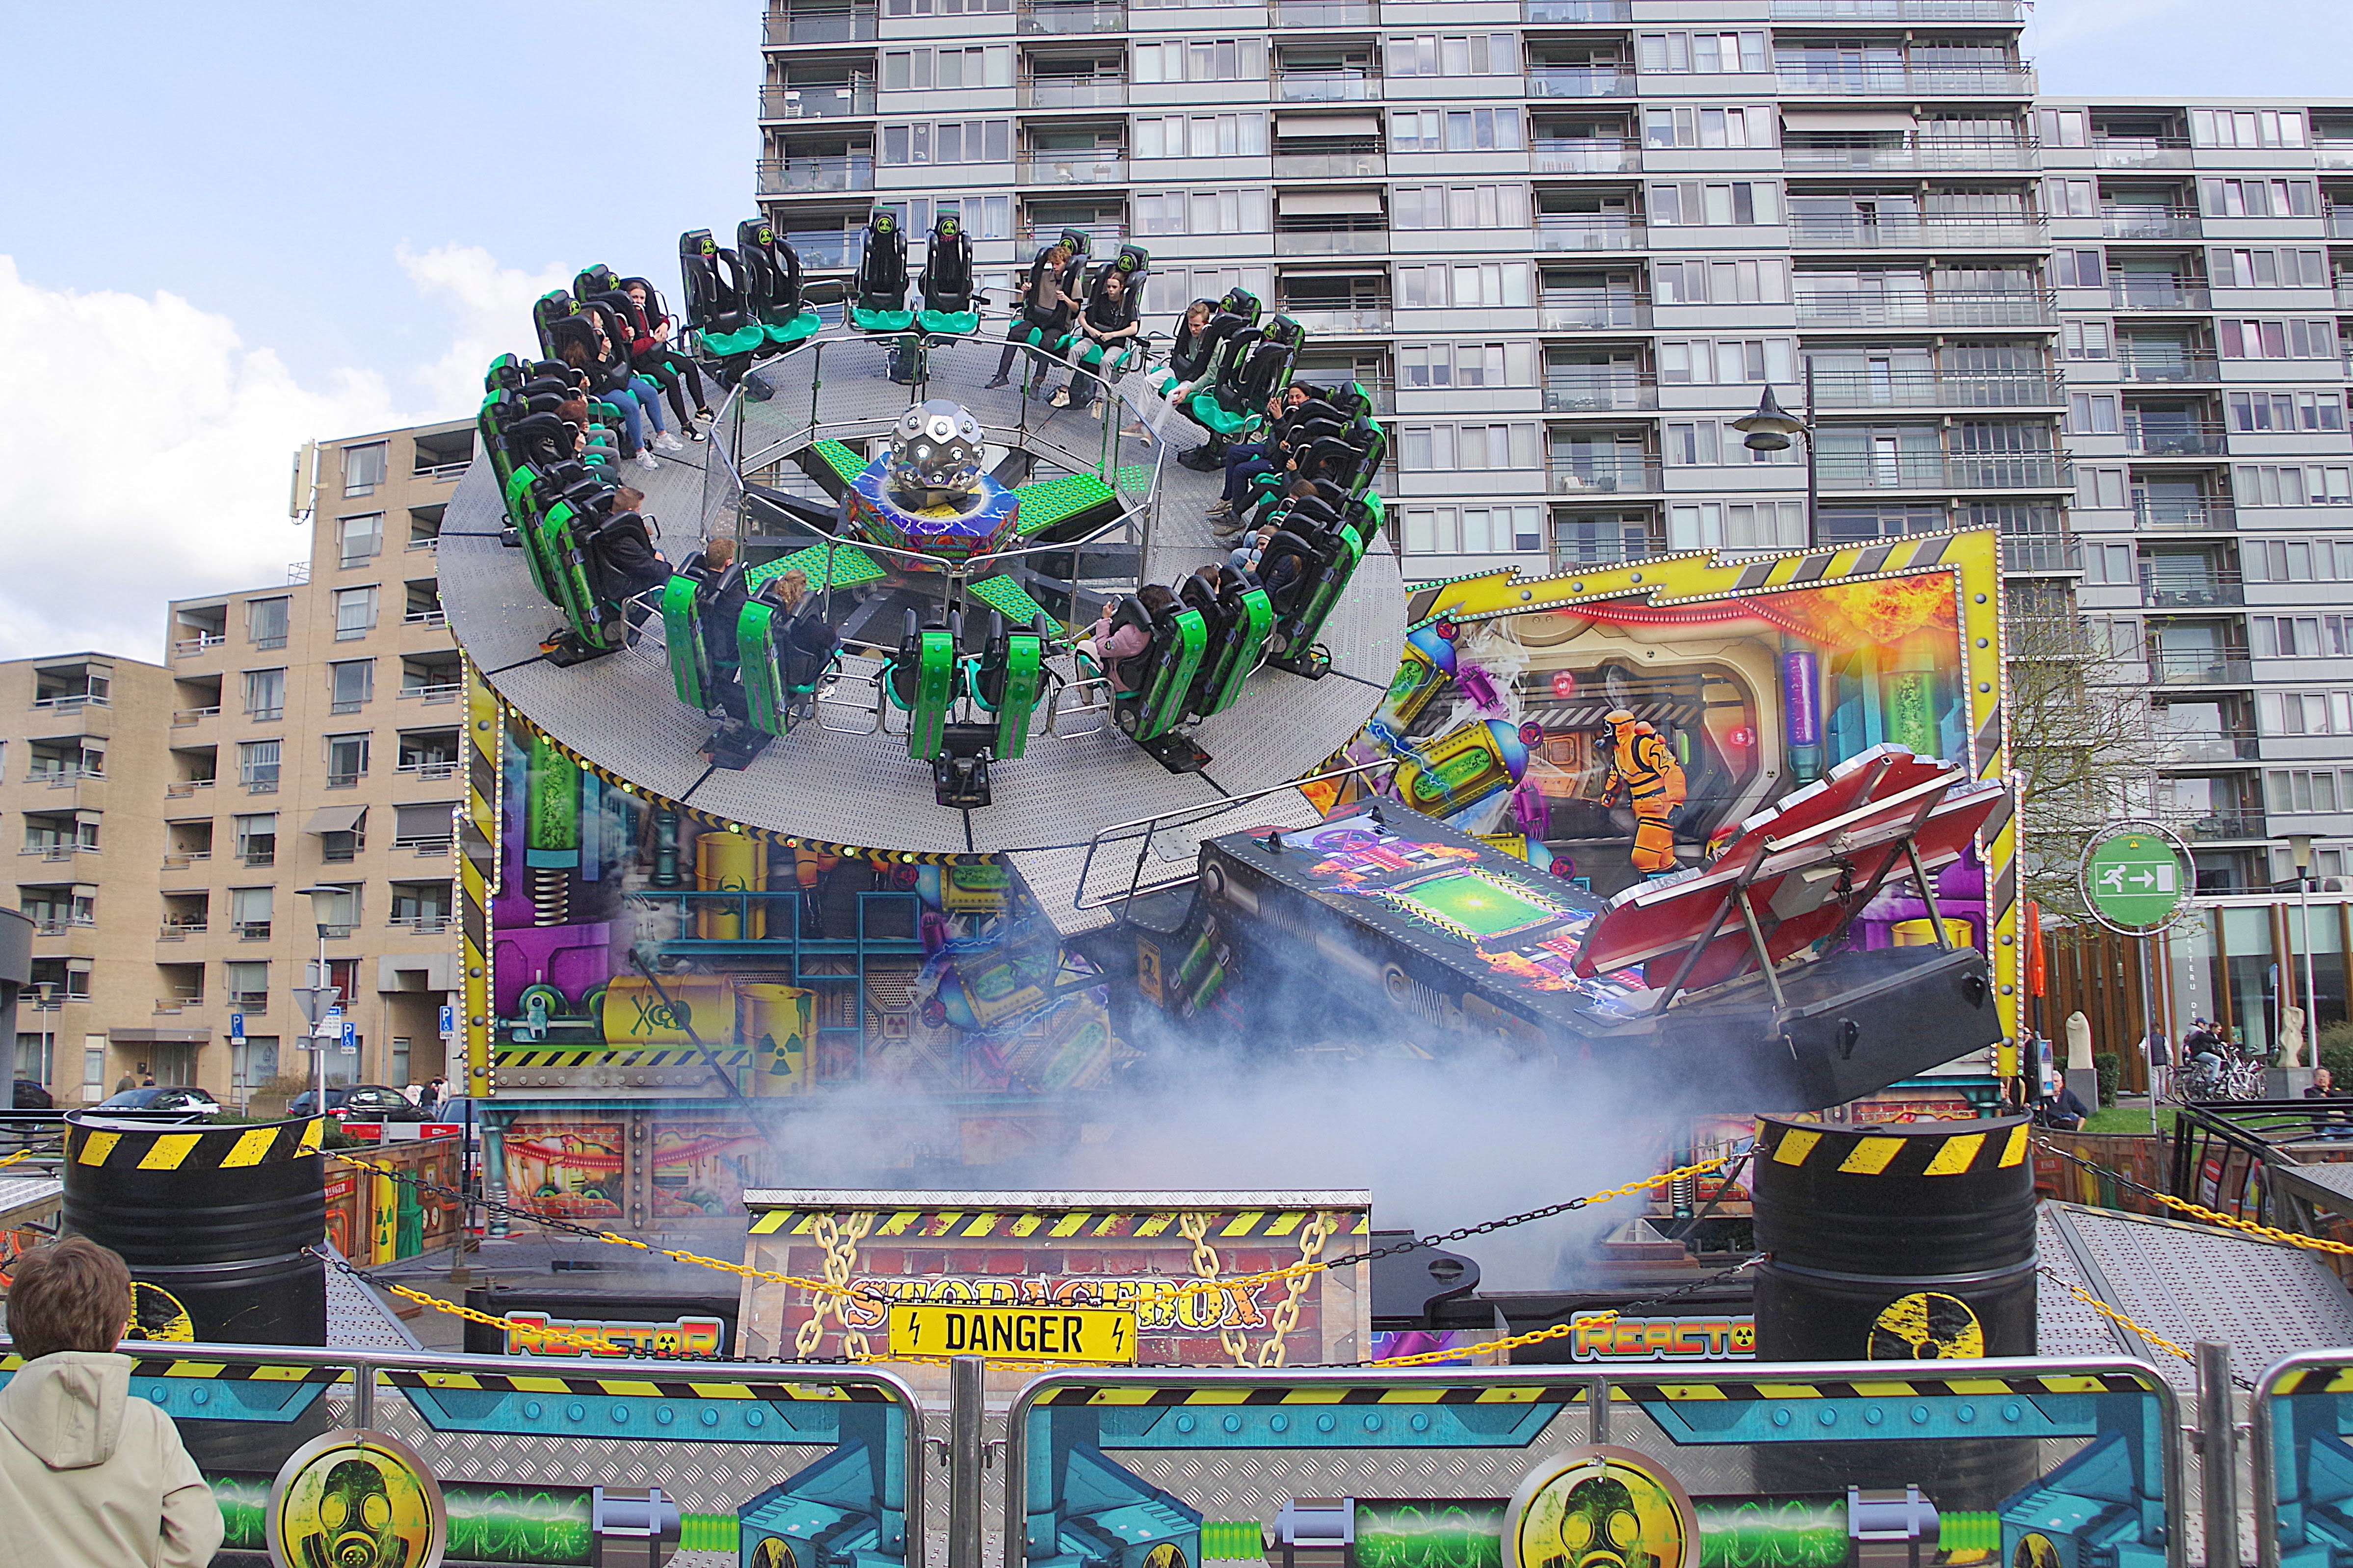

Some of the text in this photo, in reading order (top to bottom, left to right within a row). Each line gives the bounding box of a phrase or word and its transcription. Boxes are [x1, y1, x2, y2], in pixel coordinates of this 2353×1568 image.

[443, 1008, 450, 1021] P
[233, 1016, 240, 1028] P
[344, 1024, 352, 1036] P
[508, 1316, 720, 1360] REACTOR
[945, 1313, 1082, 1353] DANGER
